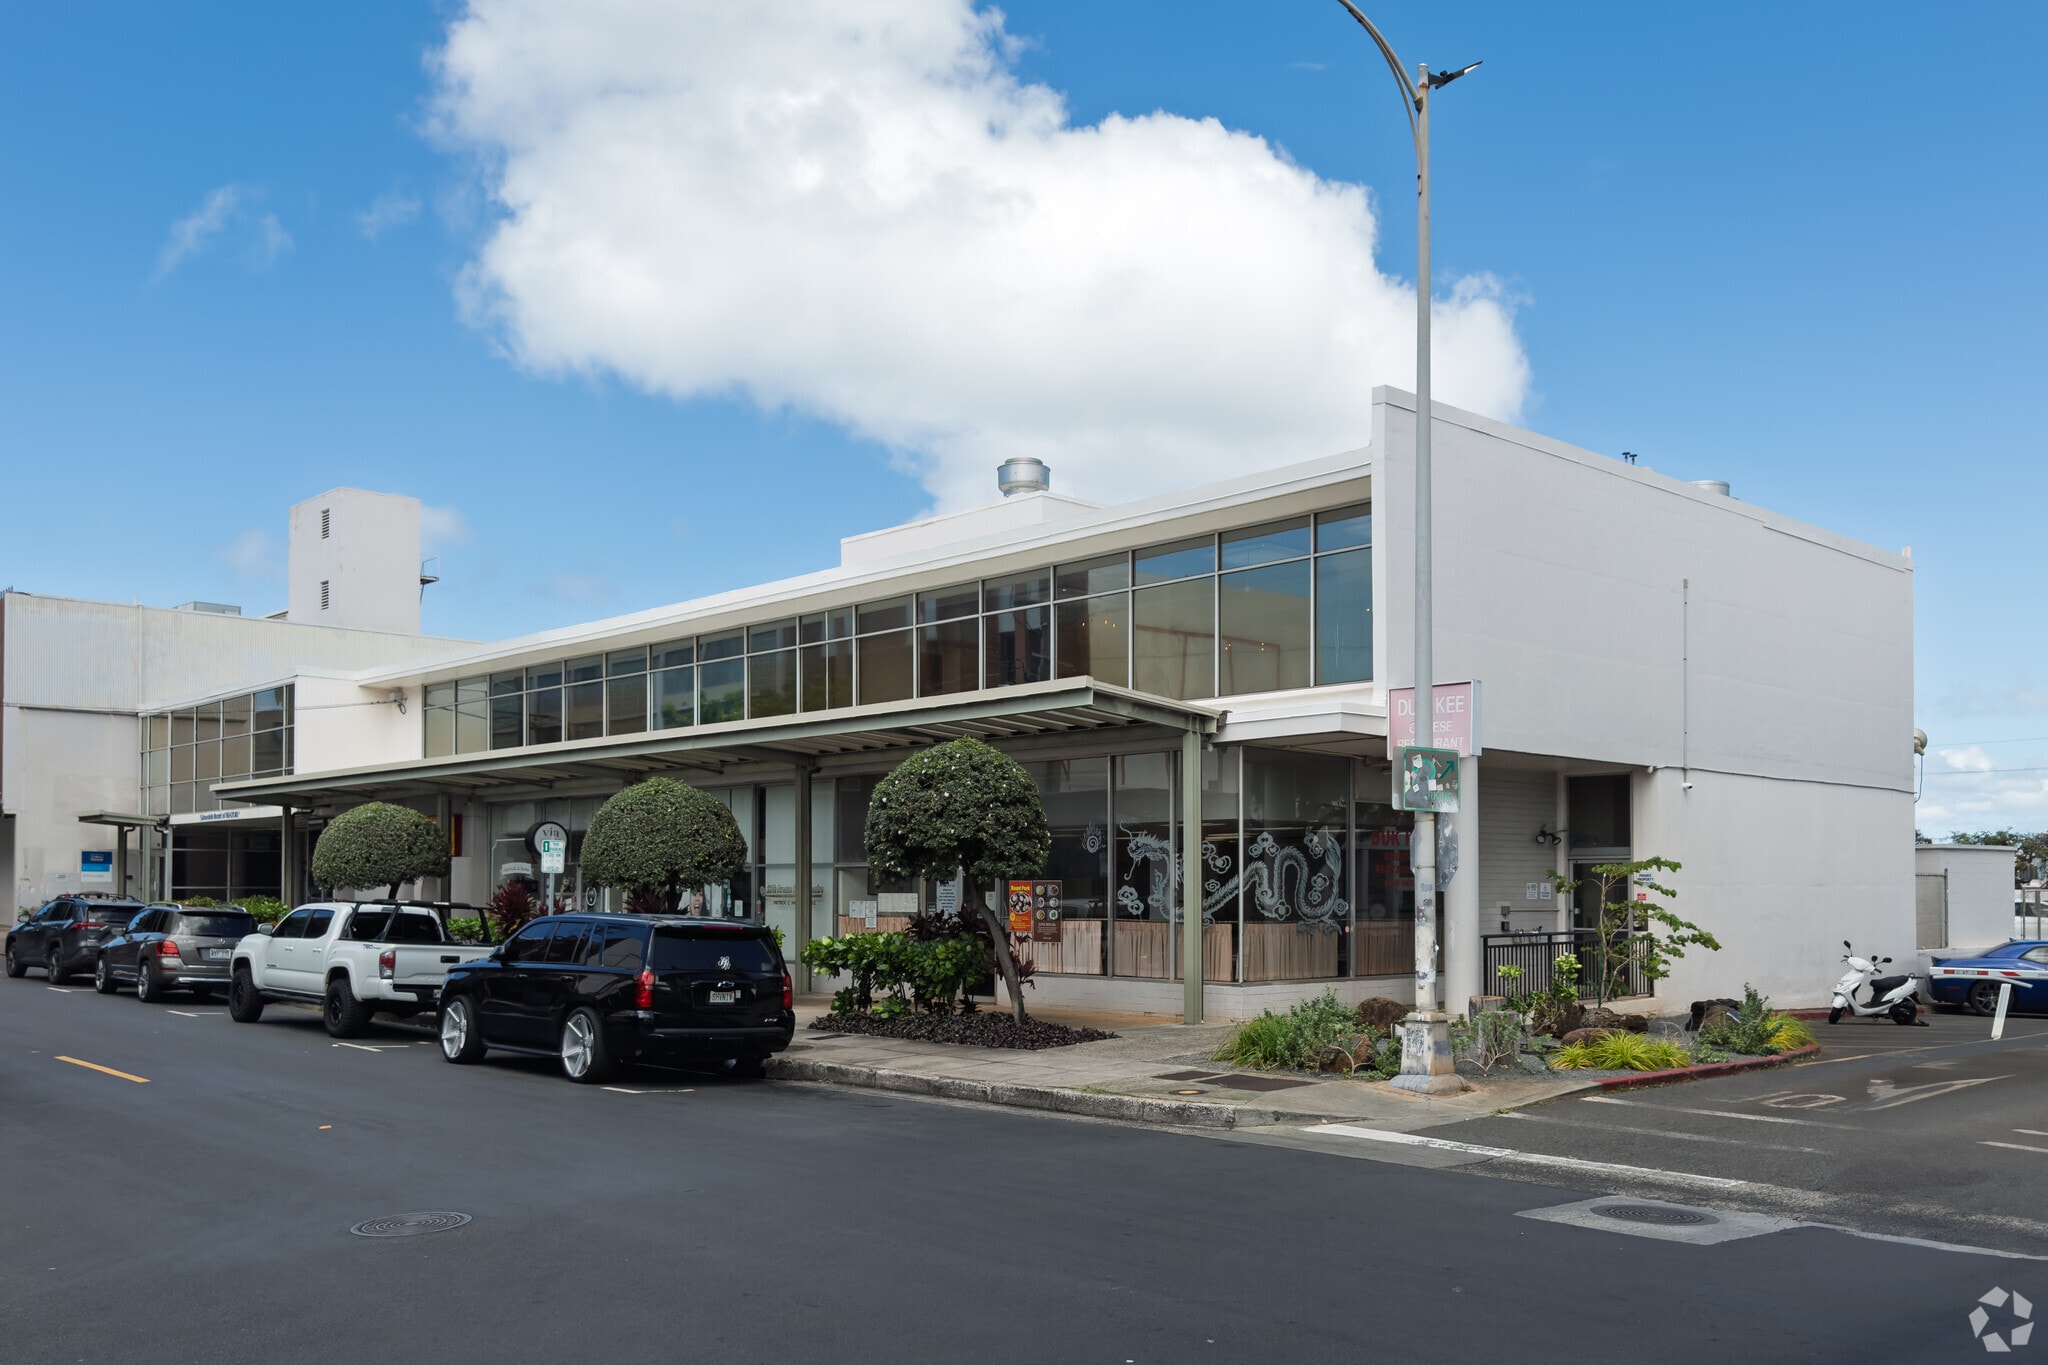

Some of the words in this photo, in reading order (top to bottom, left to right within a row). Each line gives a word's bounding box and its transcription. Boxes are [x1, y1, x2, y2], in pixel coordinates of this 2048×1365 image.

[1398, 698, 1416, 716] DU
[1435, 695, 1465, 714] KEE
[1409, 720, 1453, 734] CESE
[1428, 791, 1452, 800] RKING
[542, 827, 560, 838] via
